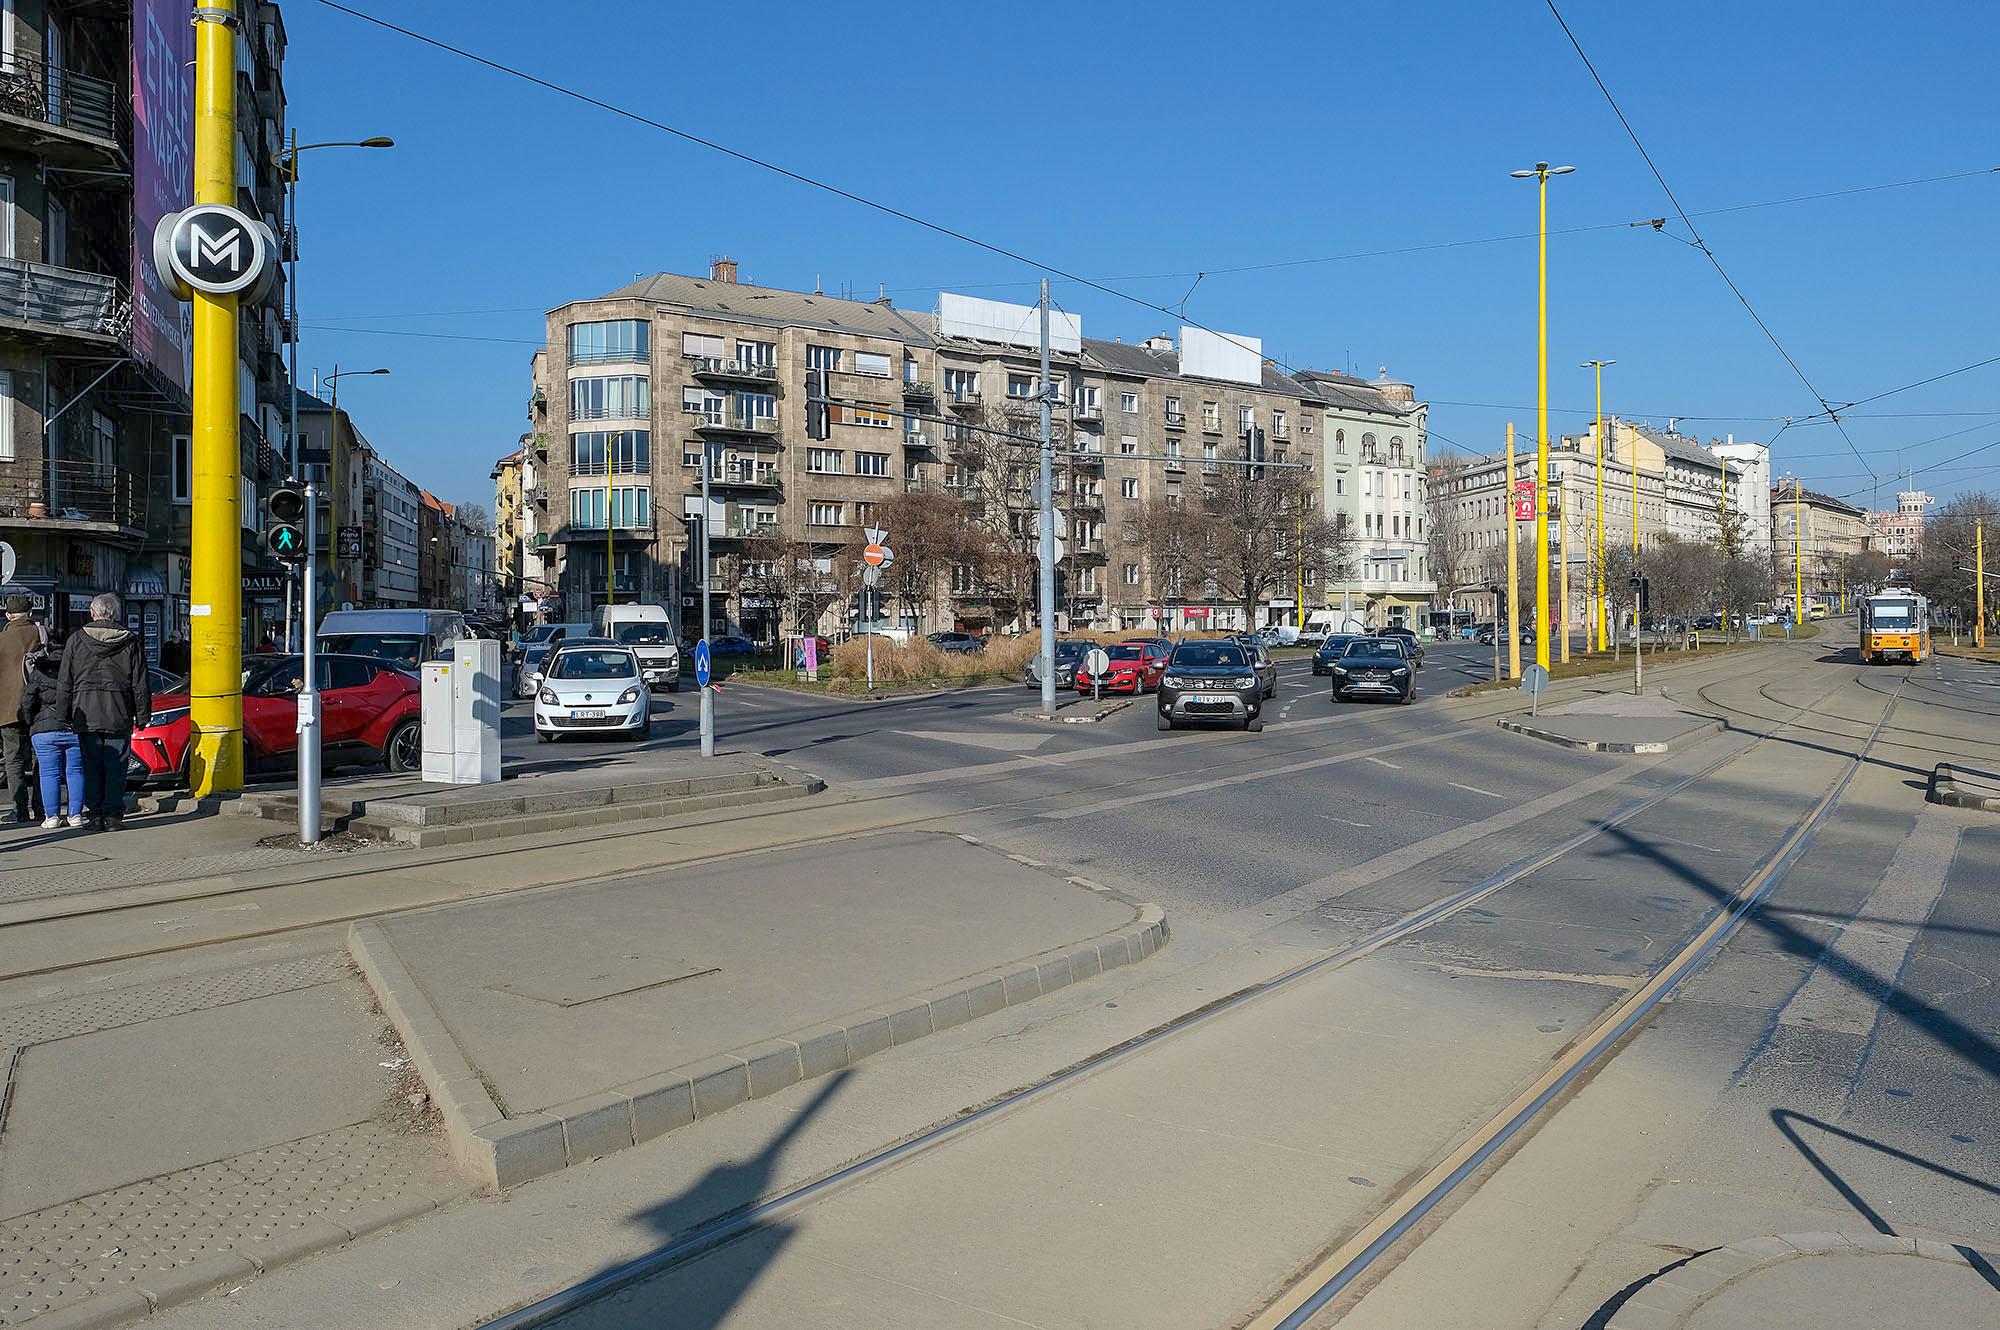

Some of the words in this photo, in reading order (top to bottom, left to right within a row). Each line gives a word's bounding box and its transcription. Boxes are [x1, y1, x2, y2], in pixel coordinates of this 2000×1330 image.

[146, 8, 189, 155] ETELE
[147, 93, 189, 207] NAPOK
[190, 223, 240, 272] M
[242, 577, 284, 587] DAILY
